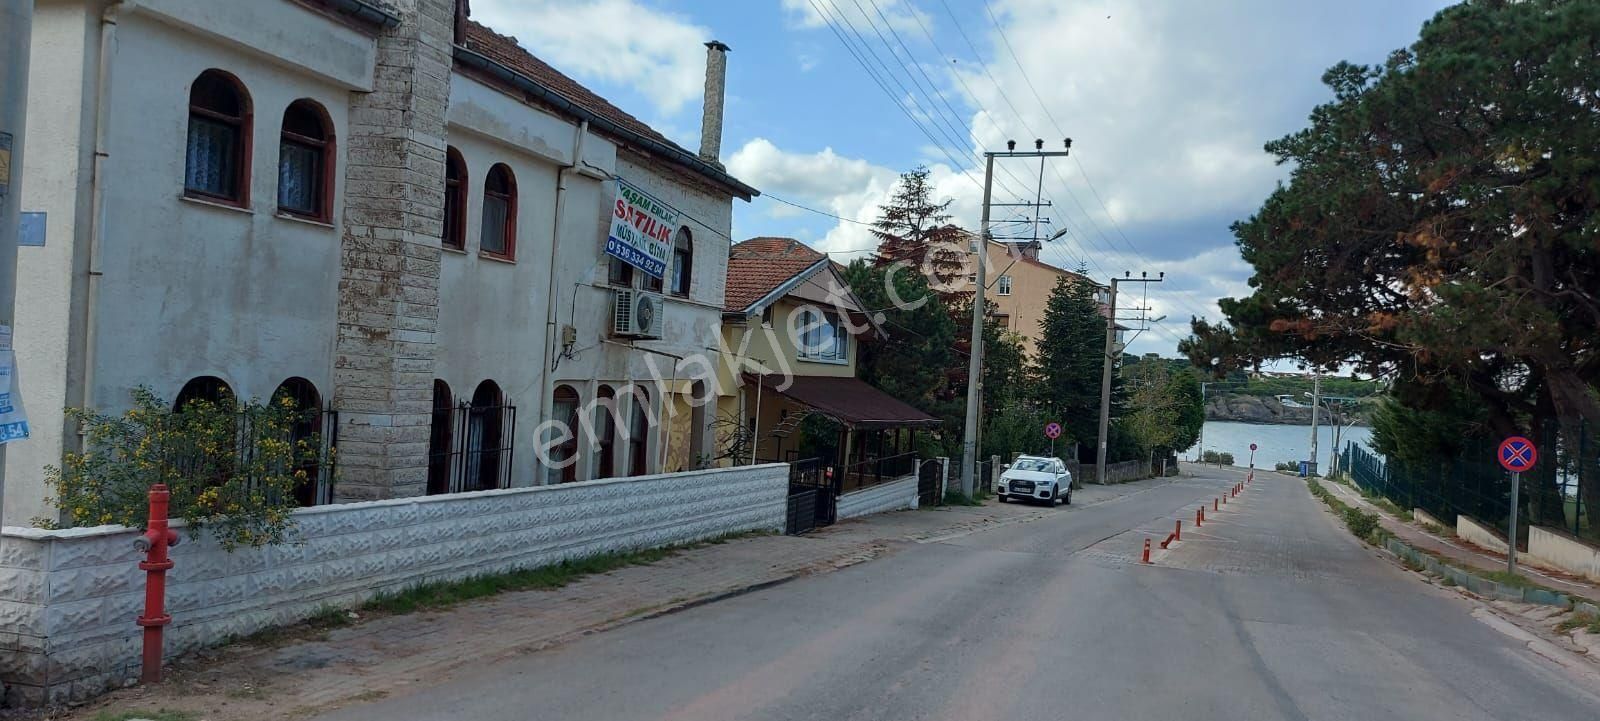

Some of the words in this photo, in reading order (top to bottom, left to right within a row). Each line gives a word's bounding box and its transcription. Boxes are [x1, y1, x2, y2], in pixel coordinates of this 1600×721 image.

[618, 184, 651, 210] YAŞAM
[614, 199, 672, 245] SATILIK
[631, 251, 645, 265] 334
